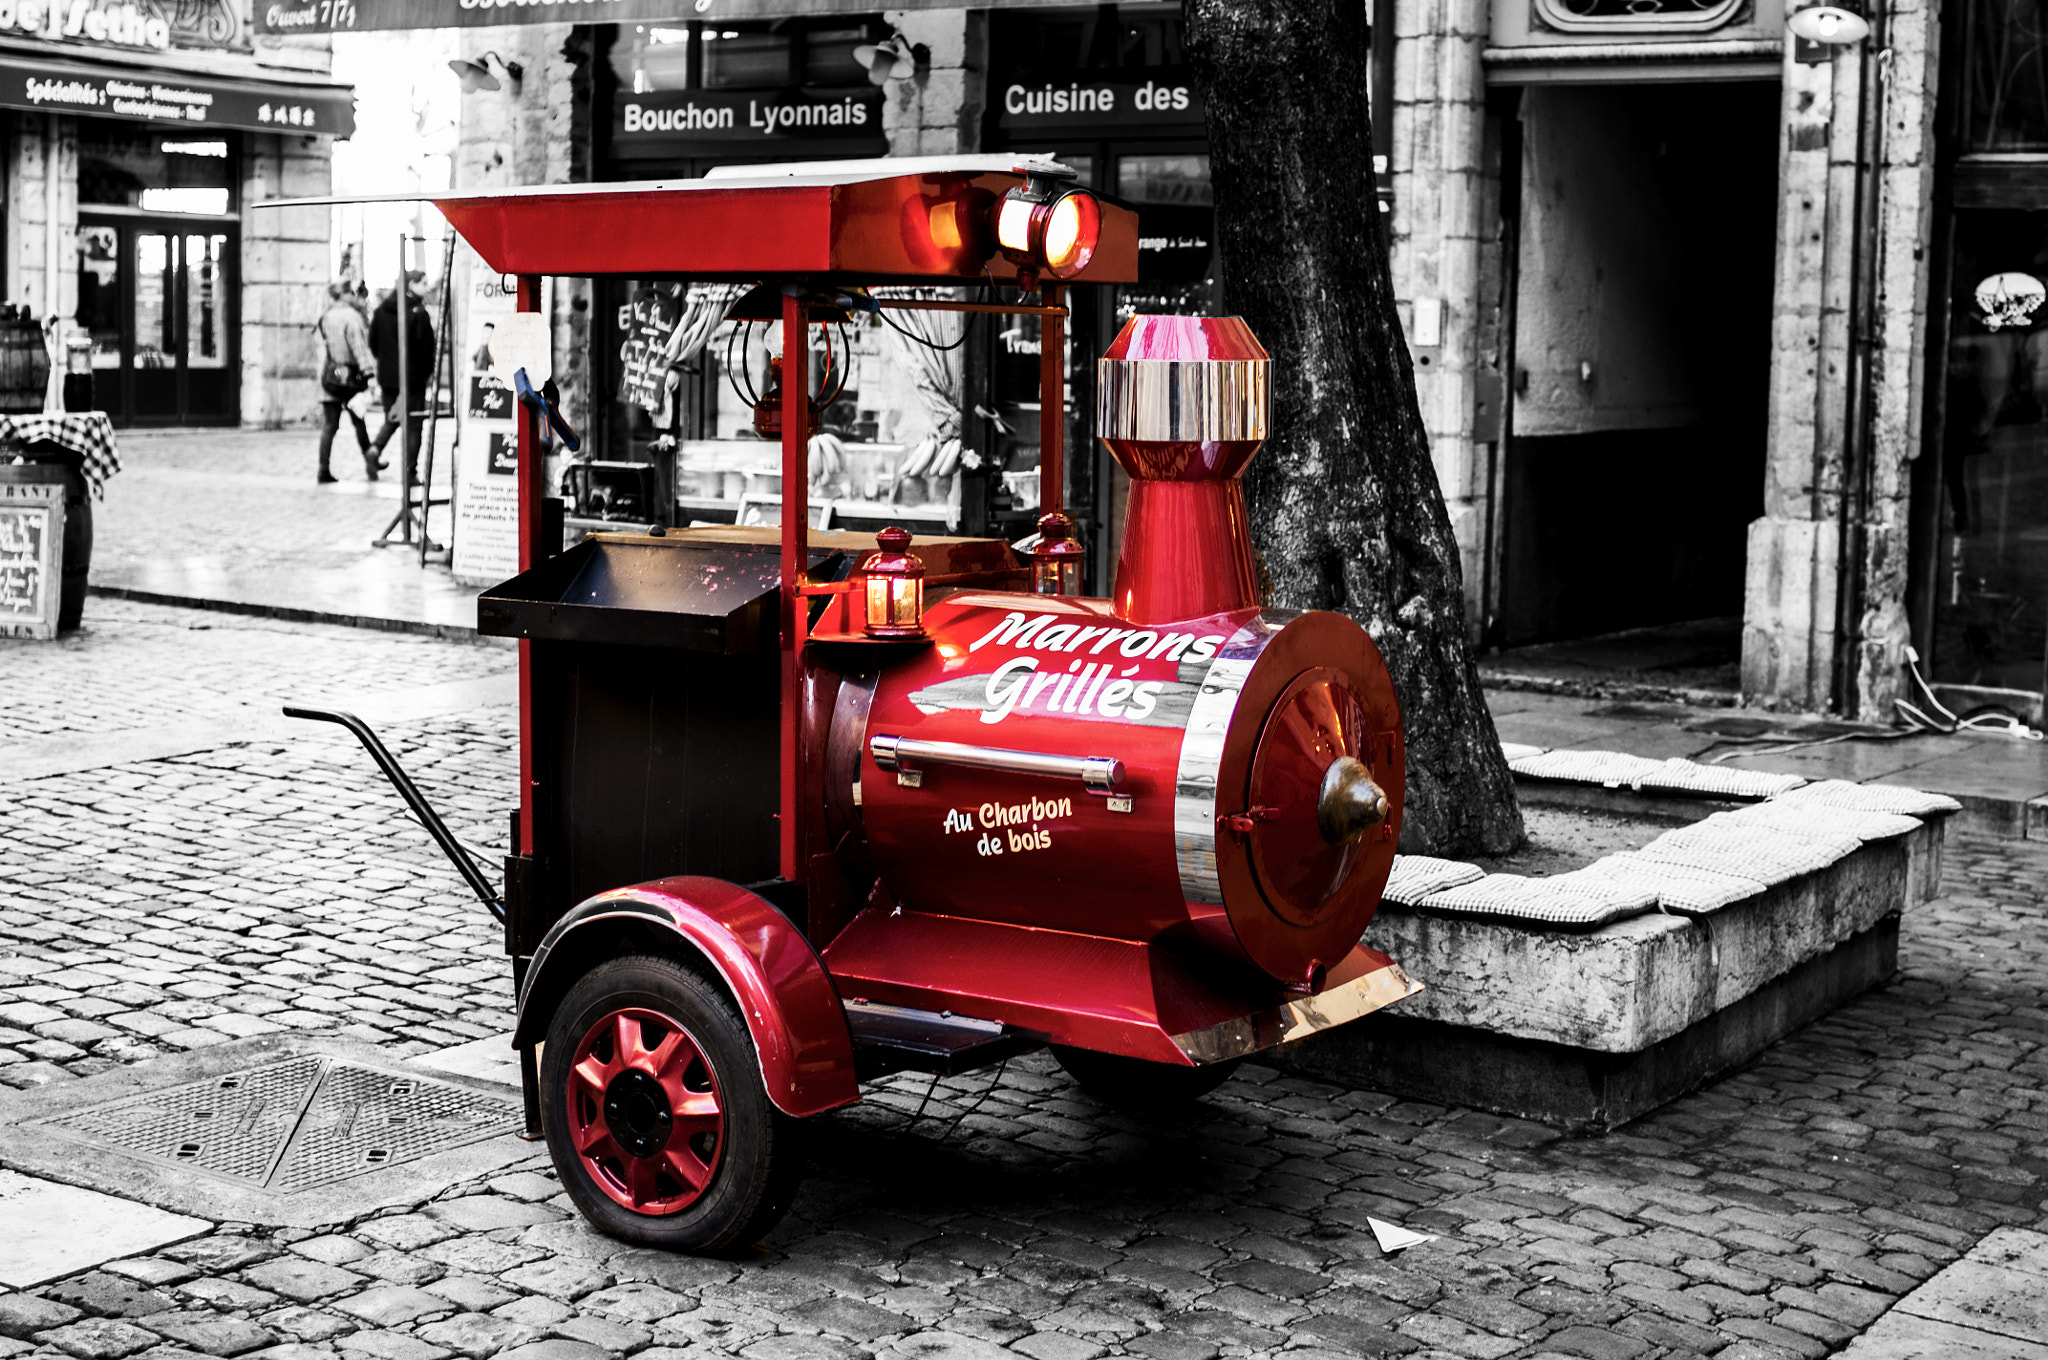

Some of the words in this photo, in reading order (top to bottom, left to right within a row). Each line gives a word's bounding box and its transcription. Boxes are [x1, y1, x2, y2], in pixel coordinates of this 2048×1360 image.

[266, 4, 317, 27] Ouvert
[624, 102, 733, 132] Bouchon
[750, 96, 868, 134] Lyonnais
[1005, 82, 1115, 114] Cuisine
[1134, 80, 1190, 110] des
[1138, 237, 1168, 252] range
[969, 611, 1227, 664] Marrons
[979, 655, 1164, 725] Grillés
[943, 808, 974, 834] Au
[978, 795, 1073, 829] Charbon
[976, 832, 1004, 857] de
[1007, 823, 1052, 853] bois
